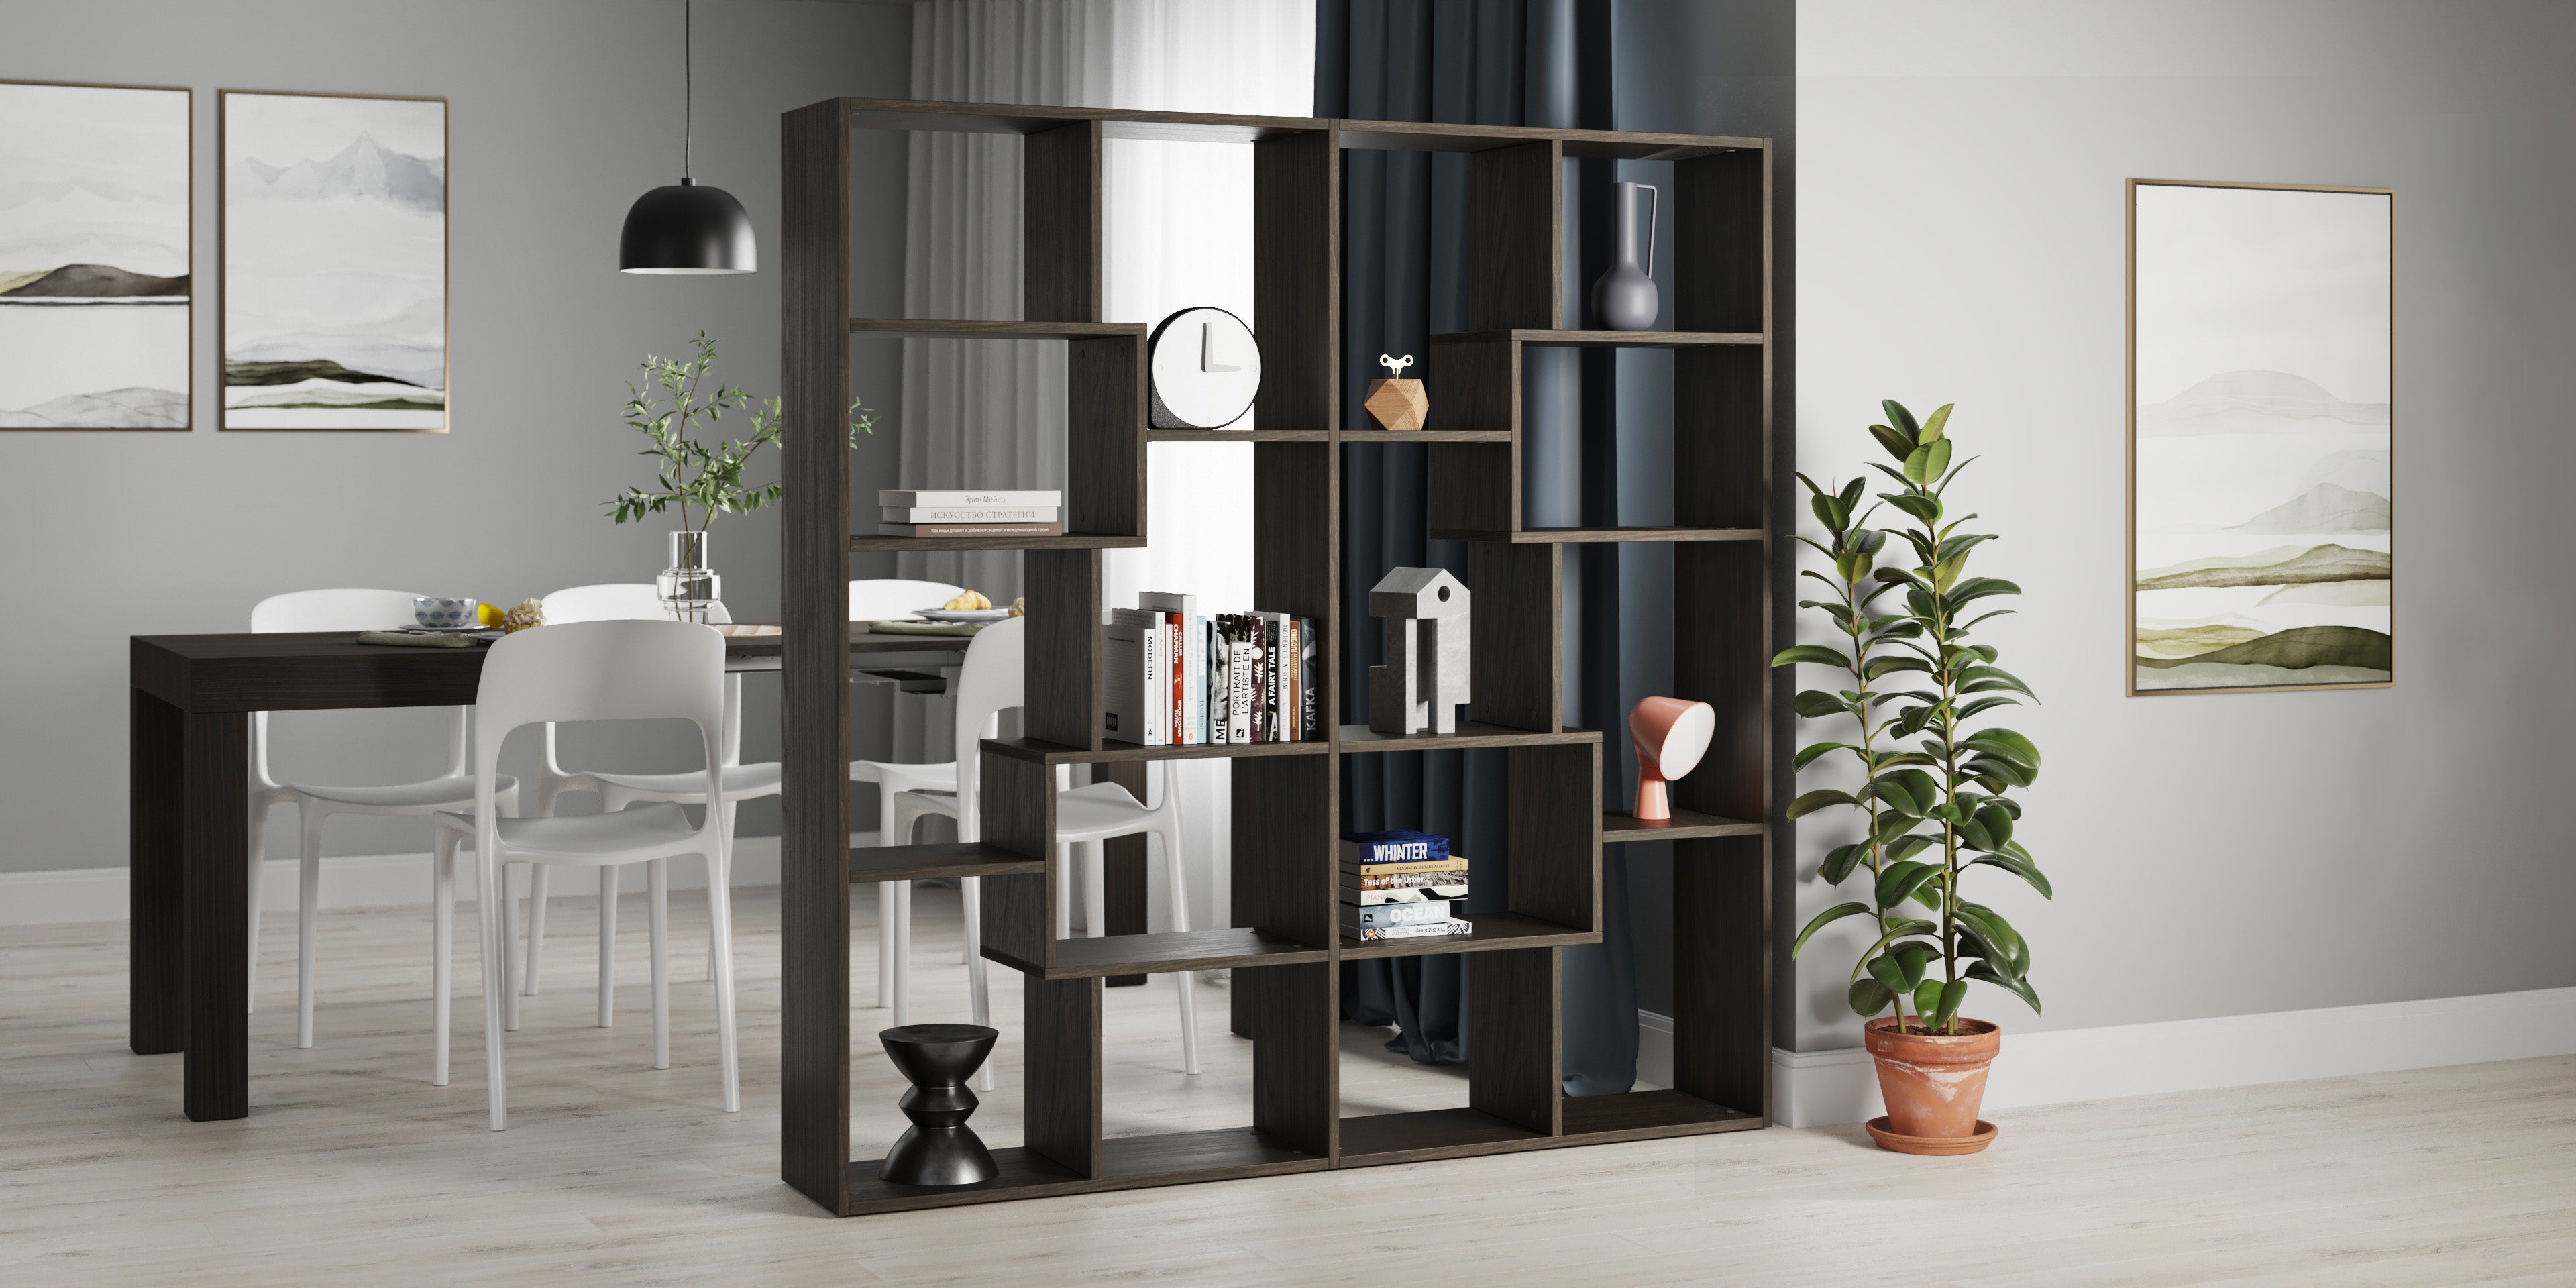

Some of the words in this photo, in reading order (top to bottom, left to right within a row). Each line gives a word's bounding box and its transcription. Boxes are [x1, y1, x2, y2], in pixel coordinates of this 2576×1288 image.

[965, 496, 981, 504] Эрин
[983, 496, 1006, 504] Мейер
[1234, 649, 1241, 663] DE
[1243, 649, 1250, 661] EN
[1232, 665, 1240, 716] PORTRAIT
[1242, 664, 1250, 714] L'ARTISTE
[1268, 698, 1275, 706] A
[1305, 687, 1316, 731] KAFKA
[1363, 878, 1379, 886] Tess
[1381, 877, 1389, 885] of
[1390, 877, 1403, 885] the
[1390, 905, 1446, 923] OCEAN
